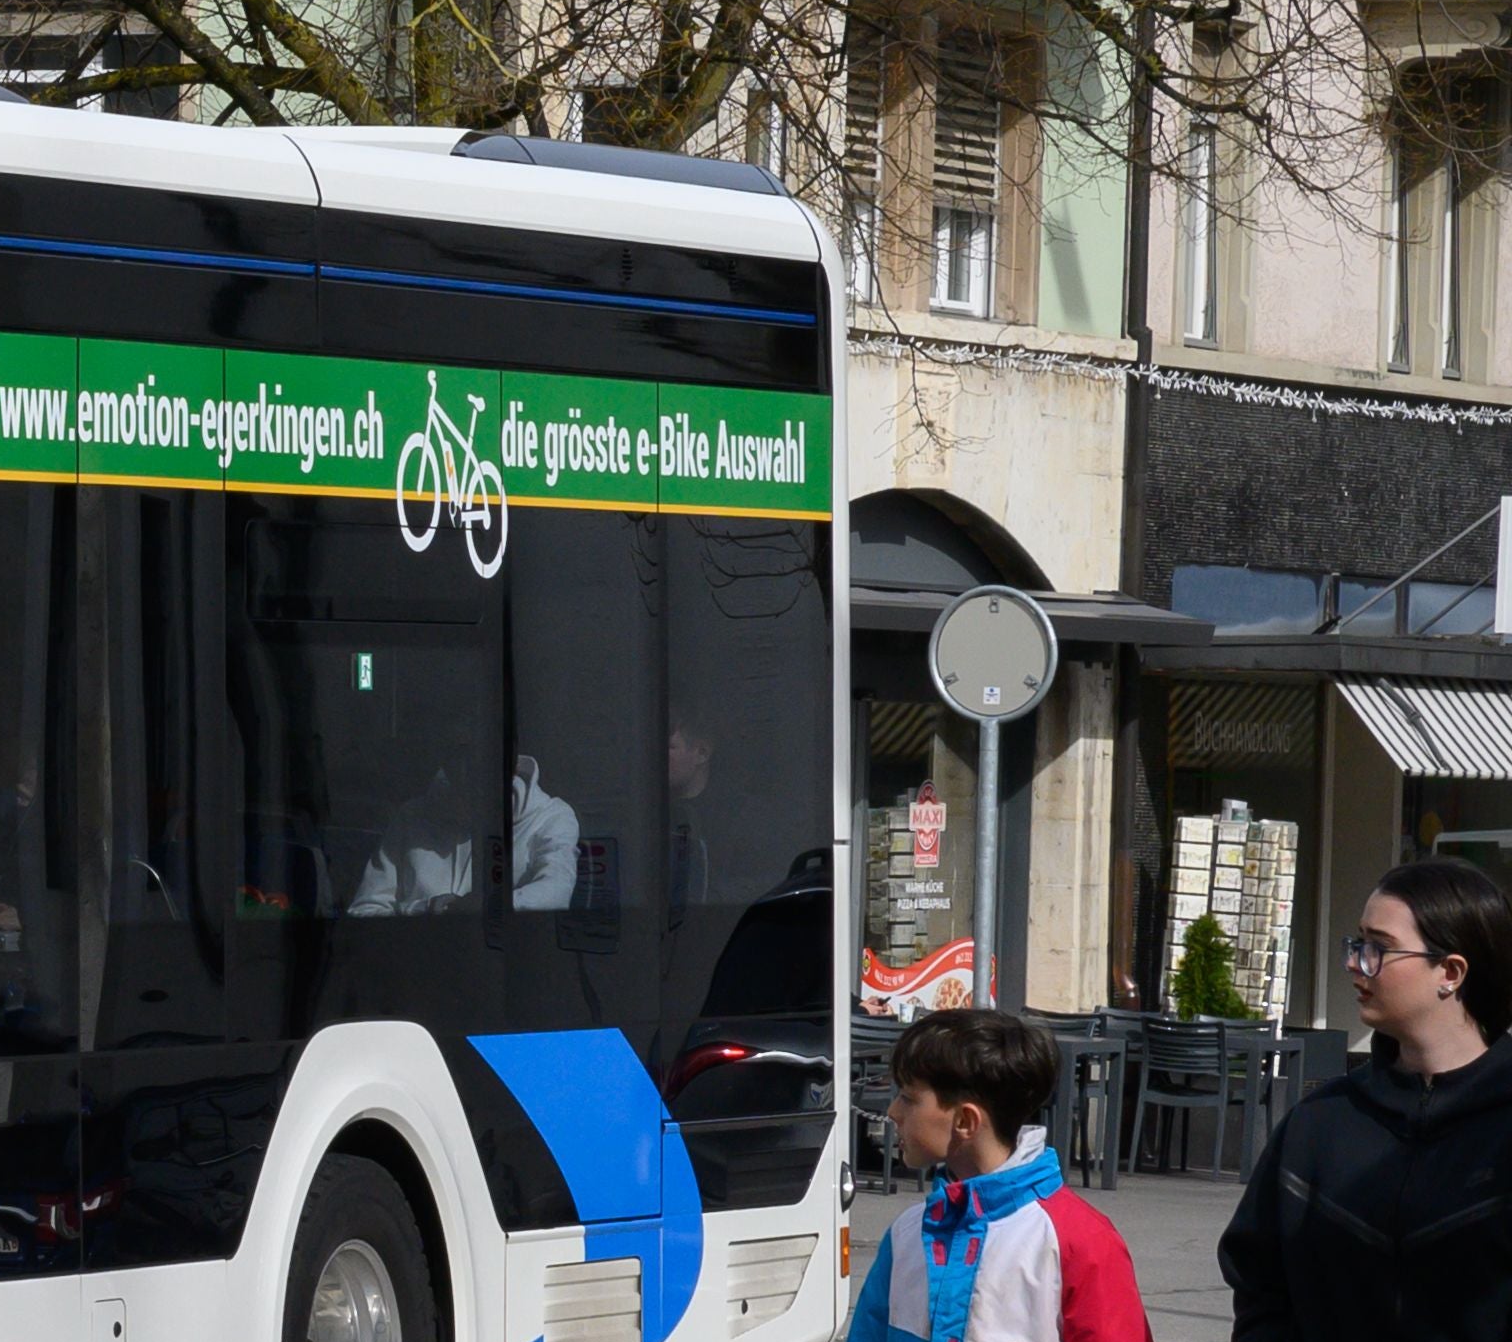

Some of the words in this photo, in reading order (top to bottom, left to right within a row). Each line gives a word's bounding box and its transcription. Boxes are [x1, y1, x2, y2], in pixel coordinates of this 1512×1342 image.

[0, 373, 384, 475] www.emotion-egerkingen.ch
[501, 400, 538, 468] die
[544, 408, 631, 488] grösste
[636, 413, 711, 480] e-Bike
[715, 419, 806, 485] Auswahl
[912, 808, 943, 827] MAXI
